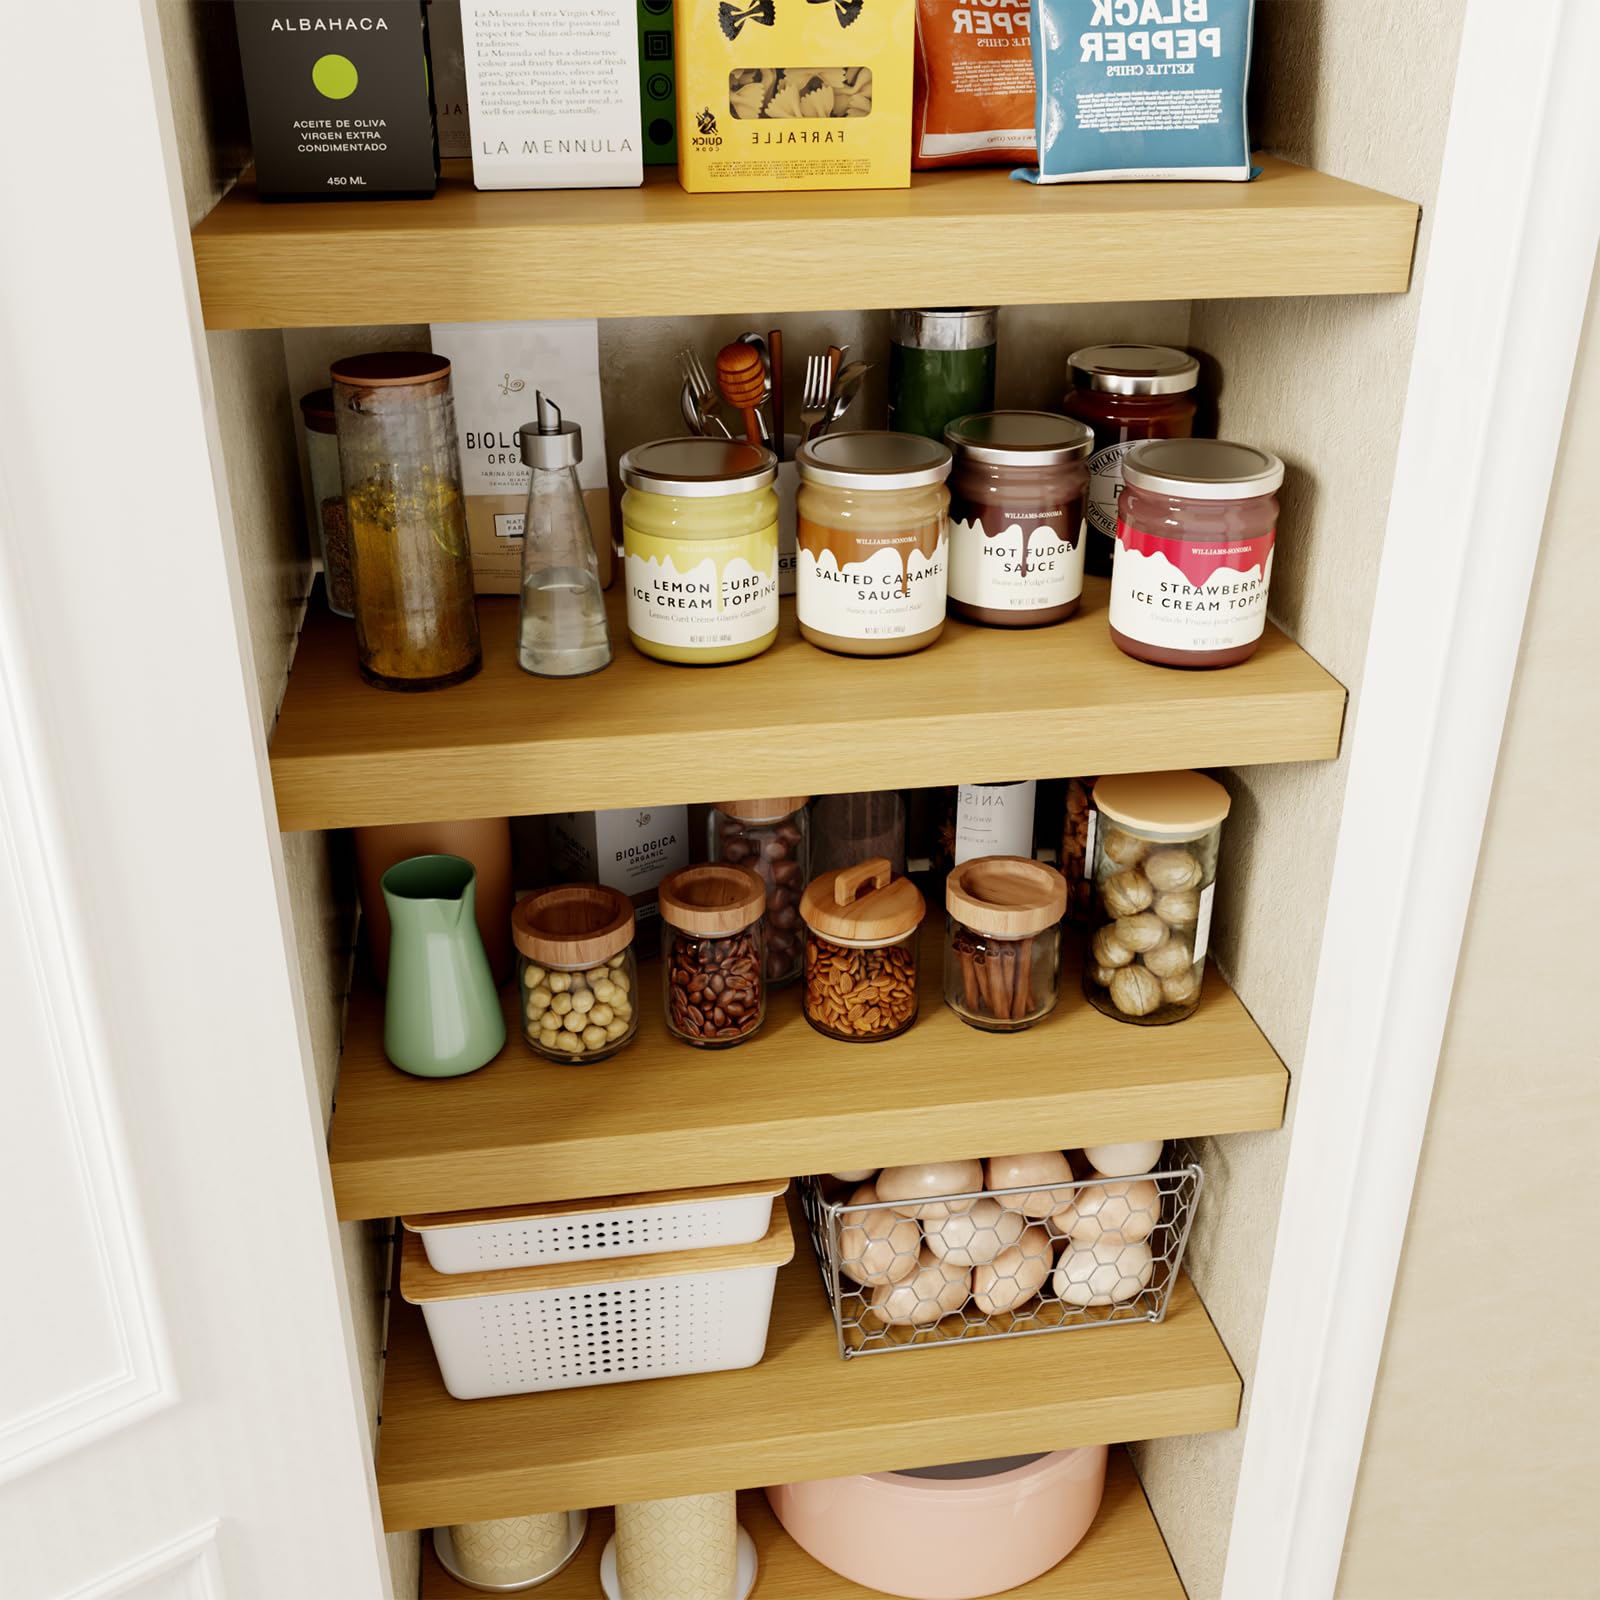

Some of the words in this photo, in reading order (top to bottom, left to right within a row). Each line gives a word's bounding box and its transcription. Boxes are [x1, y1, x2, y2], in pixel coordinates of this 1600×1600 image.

[271, 18, 389, 32] ALBAHACA
[293, 120, 332, 129] ACEITE
[336, 120, 350, 128] DE
[354, 120, 387, 128] OLIVA
[301, 132, 342, 141] VIRGEN
[346, 132, 381, 140] EXTRA
[298, 144, 388, 152] CONDIMENTADO
[483, 141, 509, 155] LA
[522, 138, 632, 154] MENNULA
[327, 177, 347, 186] 450
[350, 176, 367, 185] ML
[1004, 511, 1063, 520] WILLIAMS-SONOMA
[856, 536, 917, 545] WILLIAMS-SONOMA
[984, 546, 1017, 558] HOT
[1026, 543, 1072, 558] FUDGE
[1004, 561, 1055, 573] SAUCE
[816, 568, 873, 585] SALTED
[654, 579, 710, 594] LEMON
[1160, 578, 1262, 596] STRAWBERRY
[634, 587, 650, 602] ICE
[657, 596, 712, 609] CREAM
[722, 581, 776, 607] TOPPING
[858, 588, 911, 601] SAUCE
[1132, 590, 1153, 605] ICE
[1162, 599, 1220, 611] CREAM
[616, 835, 677, 862] BIOLOGICA
[630, 849, 664, 865] ORGANIC
